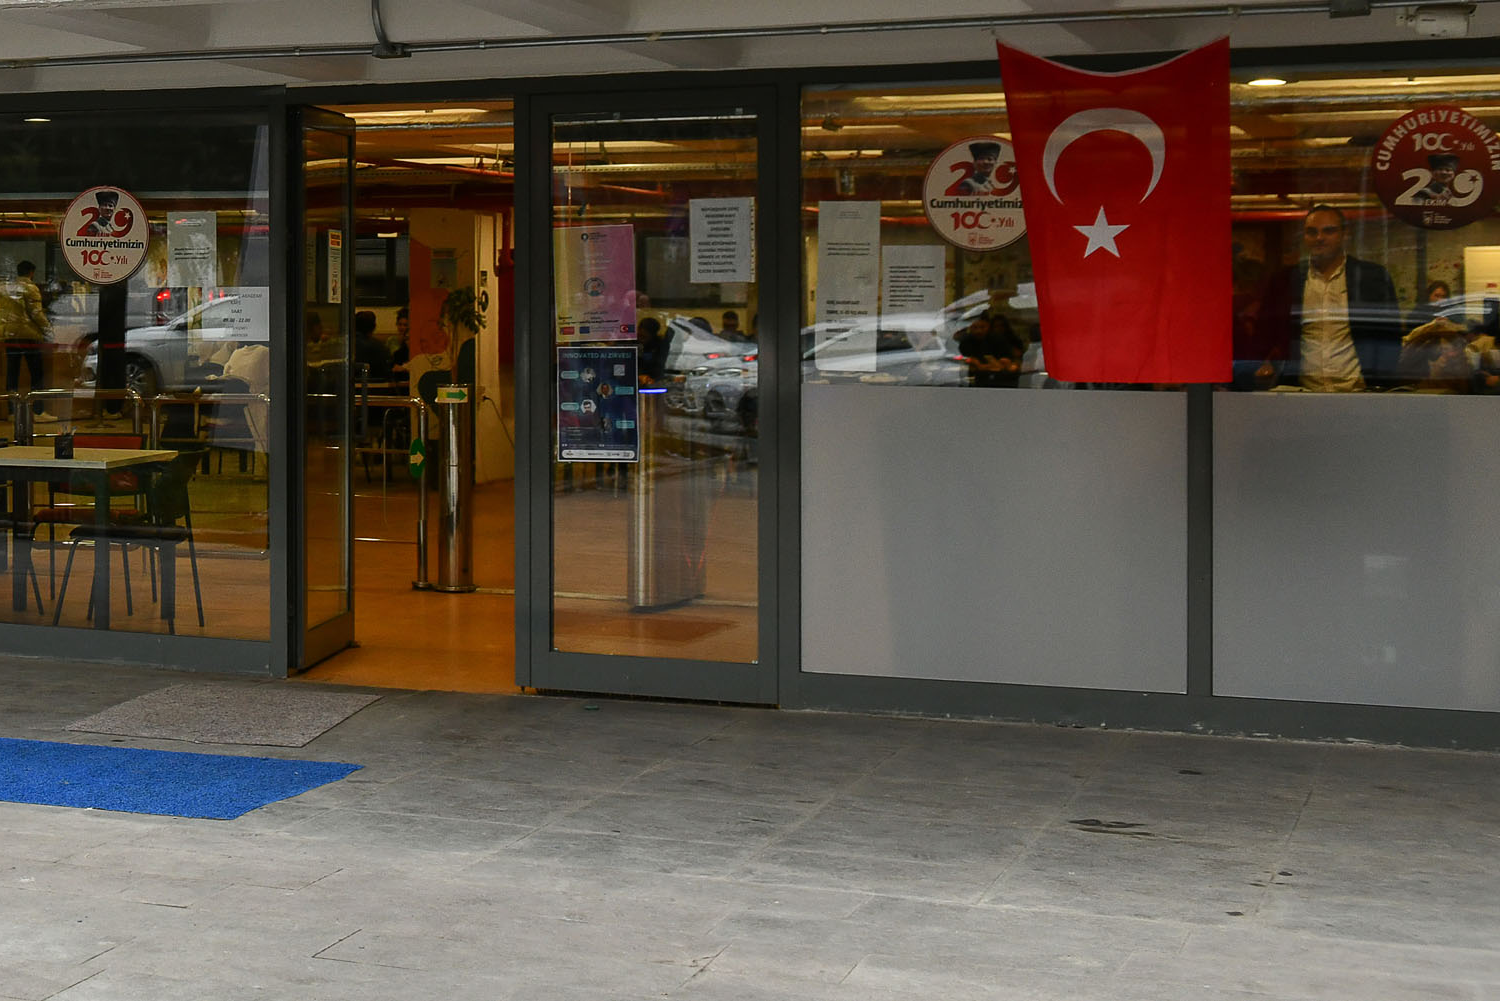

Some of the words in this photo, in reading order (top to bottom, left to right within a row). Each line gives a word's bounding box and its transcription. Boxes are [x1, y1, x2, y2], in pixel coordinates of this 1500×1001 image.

[1394, 168, 1483, 208] 29
[930, 197, 1023, 210] Cumhuriyetimiz
[76, 207, 134, 238] 29
[66, 237, 144, 249] Cumhuriyetimizin
